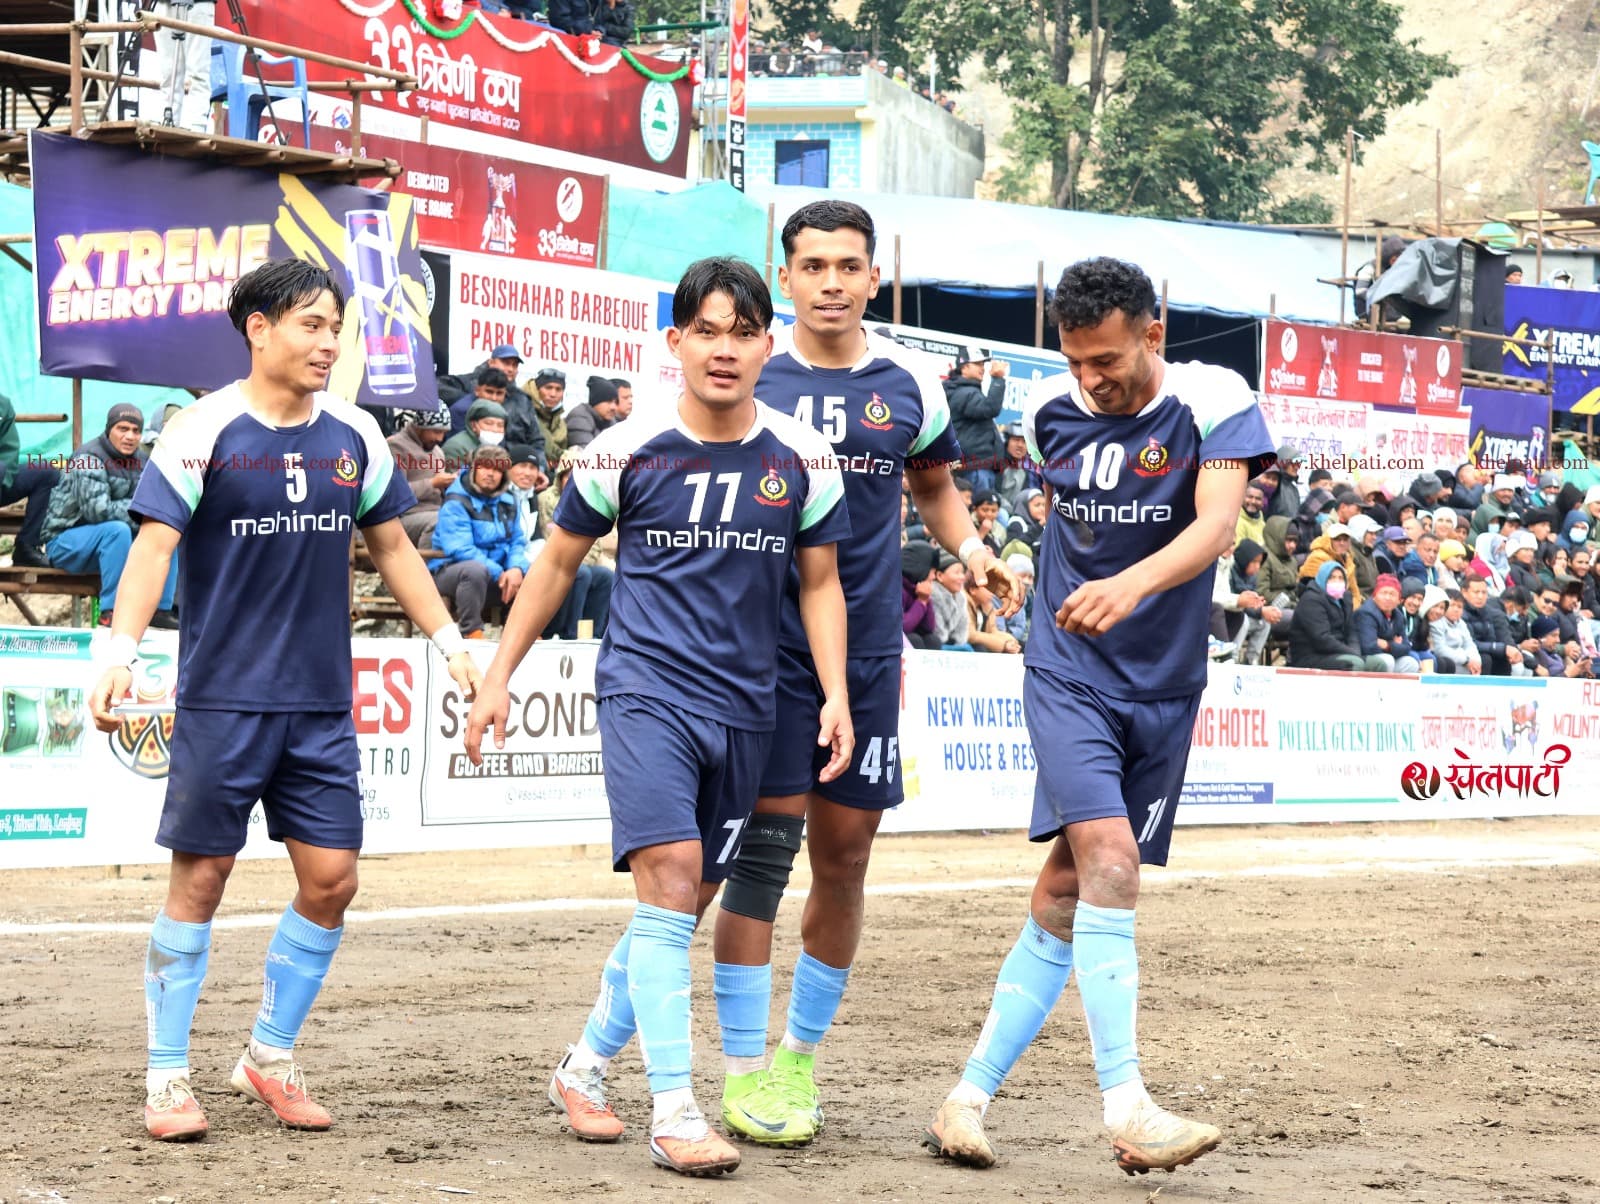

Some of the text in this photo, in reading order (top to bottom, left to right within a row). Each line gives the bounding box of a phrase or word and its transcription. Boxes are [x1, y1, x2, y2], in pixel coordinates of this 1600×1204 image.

[416, 43, 478, 102] त्रिवेणी
[482, 68, 522, 112] कप
[407, 171, 450, 193] DEDICATED
[50, 224, 271, 292] XTREME
[48, 284, 175, 325] ENERGY
[460, 272, 564, 319] BESISHAHAR
[571, 290, 649, 333] BARBEQUE
[471, 319, 643, 373] PARK & RESTAURANT
[1530, 351, 1574, 365] ENRGY
[793, 396, 847, 443] 45
[285, 453, 308, 503] 5
[1078, 441, 1125, 490] 10
[684, 471, 743, 523] 11
[231, 508, 352, 536] mahindr
[646, 524, 786, 554] mahindra
[352, 658, 413, 734] ES
[927, 696, 1028, 727] NEW WATER
[1219, 707, 1269, 748] HOTEL
[1278, 720, 1327, 751] POTALA
[1332, 720, 1370, 752] GUEST
[1376, 721, 1415, 752] HOUSE
[1553, 713, 1600, 739] MOUNT
[359, 747, 410, 776] TRO
[512, 754, 545, 776] AND
[549, 752, 604, 775] BARIST
[859, 736, 898, 784] 45
[943, 742, 1037, 771] HOUSE & RES
[715, 811, 752, 864] 1
